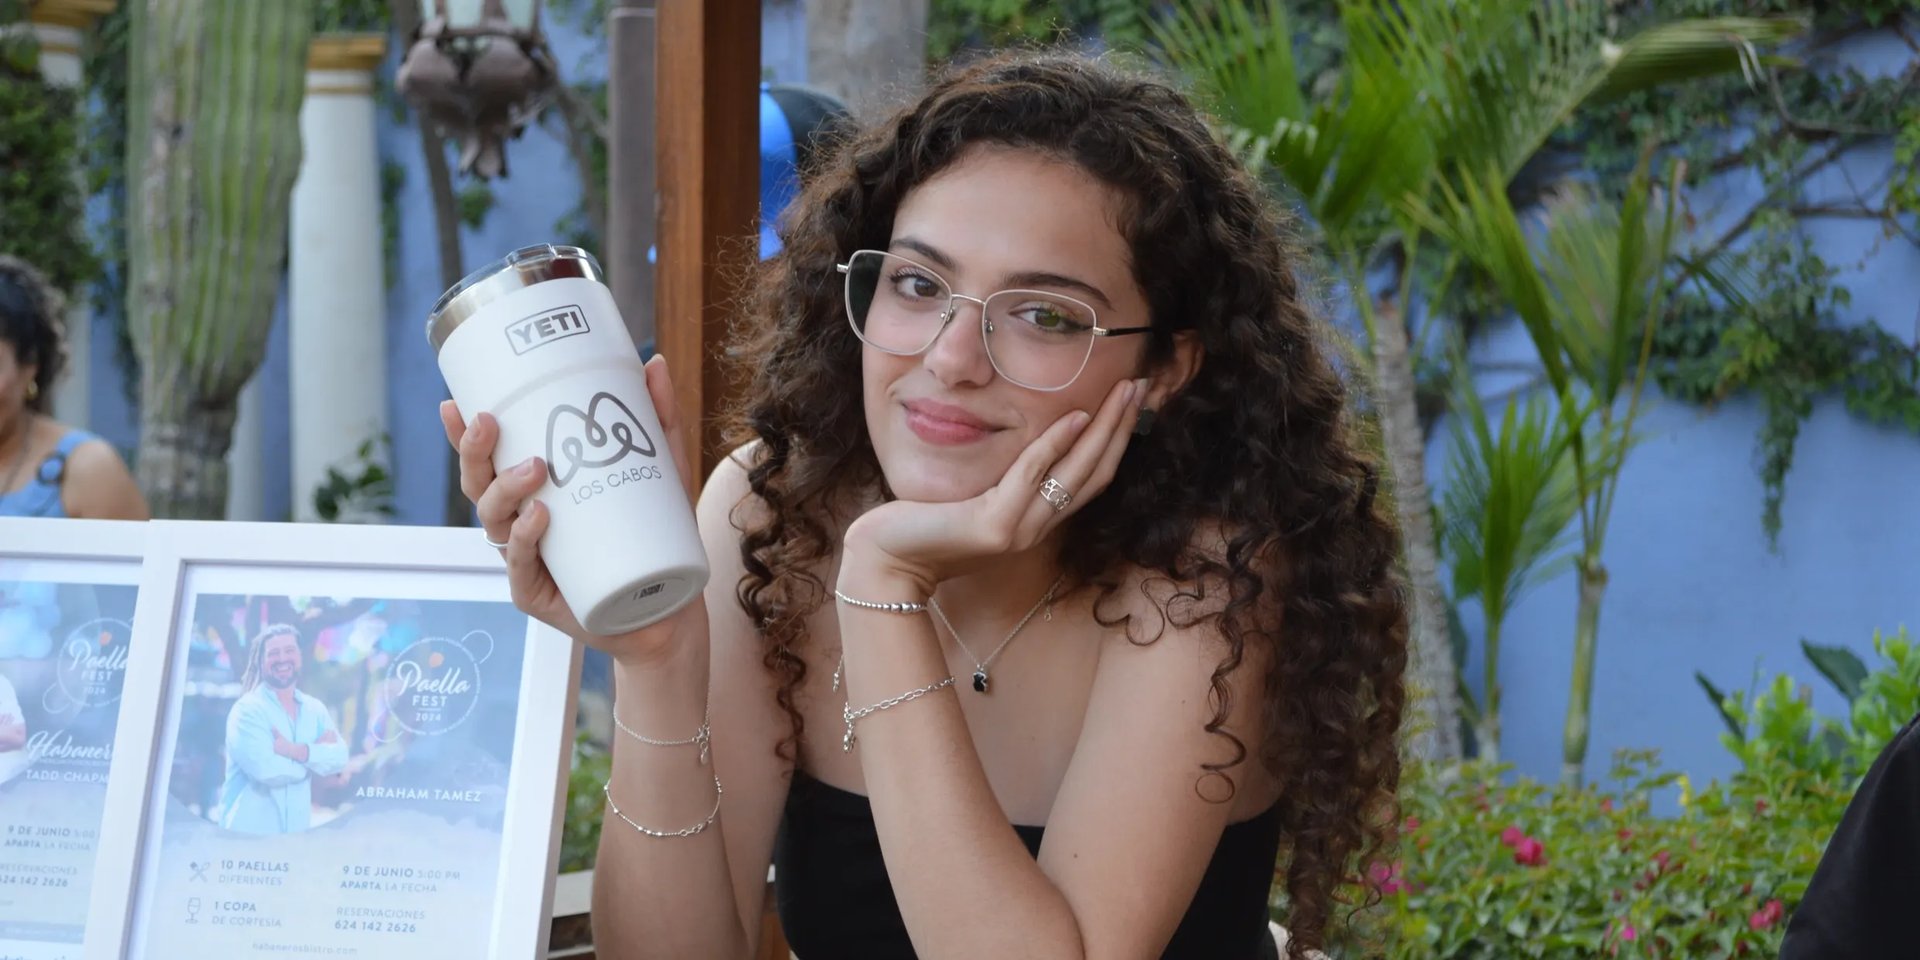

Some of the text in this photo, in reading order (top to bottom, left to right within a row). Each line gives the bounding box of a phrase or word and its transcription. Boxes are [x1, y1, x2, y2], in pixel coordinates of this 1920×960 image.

[512, 311, 582, 345] YETI
[571, 465, 662, 505] LOS CABOS
[81, 670, 112, 681] FEST
[396, 660, 471, 696] Paella
[412, 695, 447, 707] FEST
[415, 712, 441, 721] 2024
[26, 769, 59, 780] TADD
[356, 786, 482, 802] ABRAHAM TAMEZ
[8, 825, 14, 834] 9
[18, 825, 33, 836] DE
[35, 827, 71, 837] JUNIO
[4, 839, 41, 849] APARTA
[221, 860, 289, 873] 10 PAELLAS
[343, 865, 461, 881] 9 DE JUNIO 5:00 PM
[20, 876, 39, 886] 142
[41, 877, 68, 888] 2626
[218, 874, 283, 886] DIFERENTES
[340, 881, 437, 893] APARTA LA FECHA
[223, 901, 257, 912] COPA
[336, 906, 426, 920] RESERVACIONES
[211, 915, 226, 925] DE
[334, 920, 417, 933] 624 142 2626
